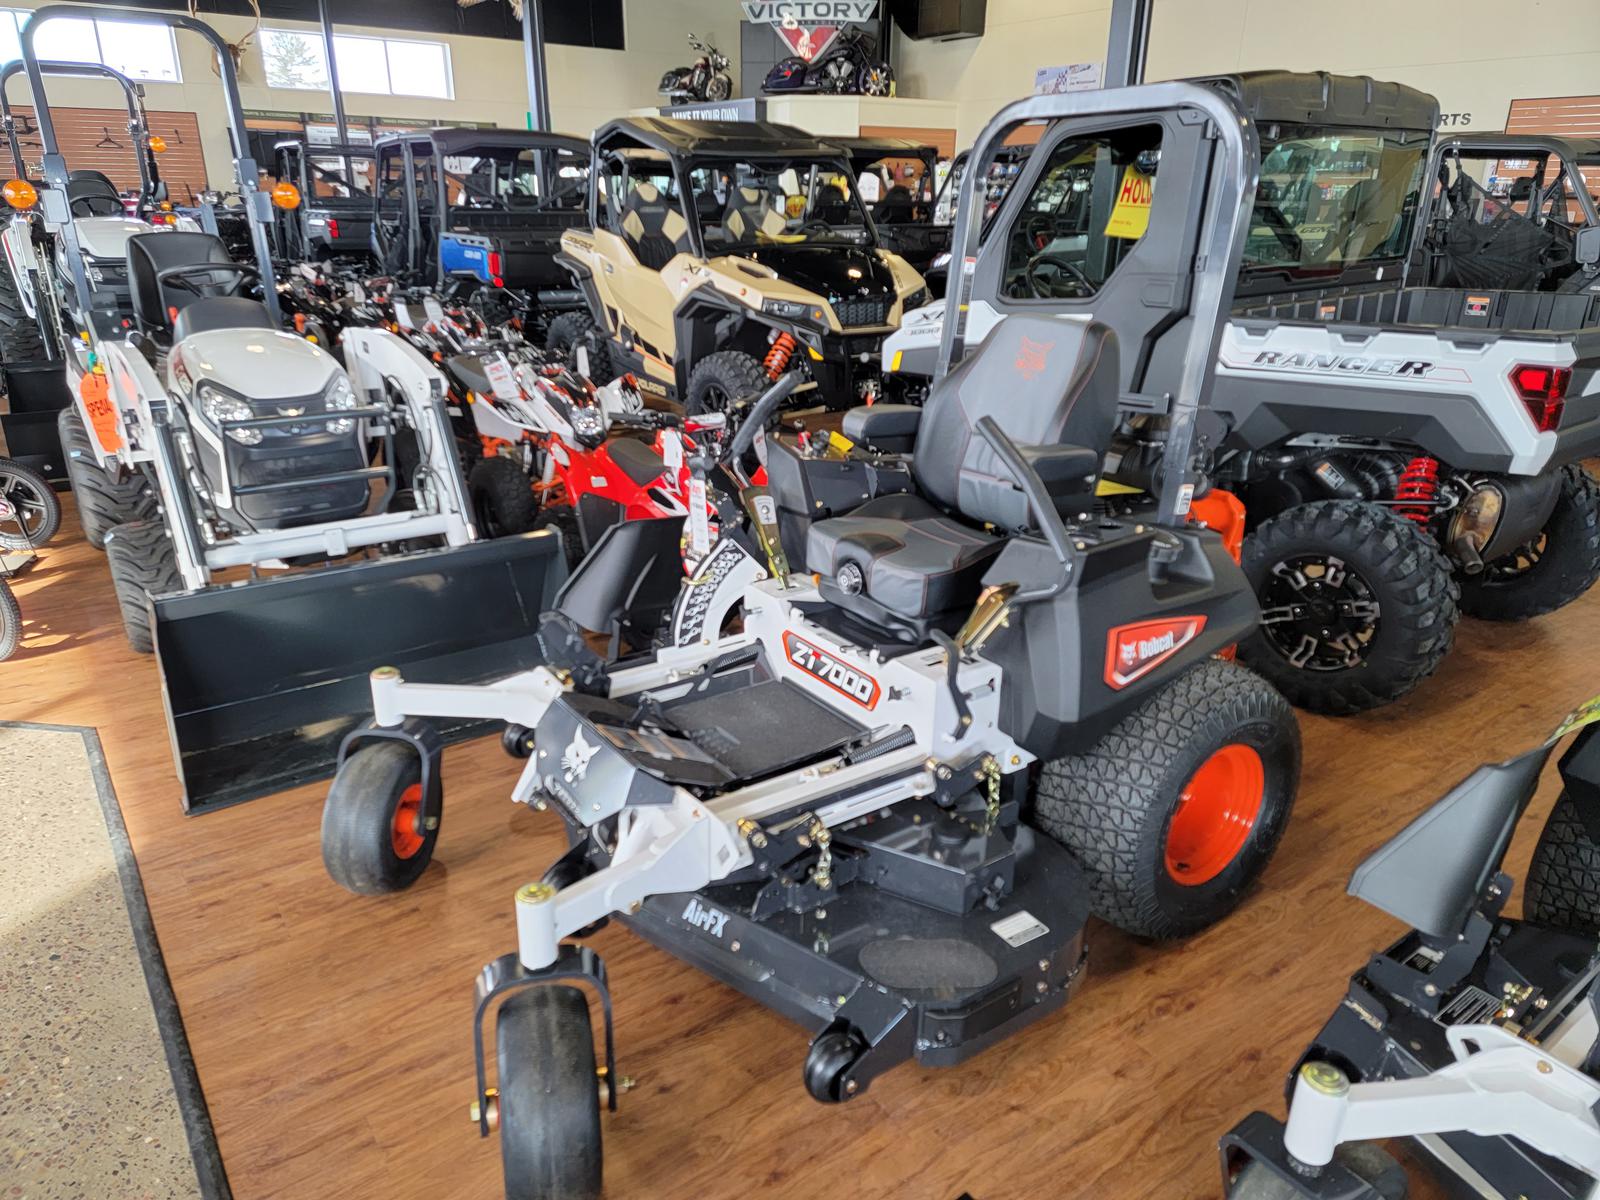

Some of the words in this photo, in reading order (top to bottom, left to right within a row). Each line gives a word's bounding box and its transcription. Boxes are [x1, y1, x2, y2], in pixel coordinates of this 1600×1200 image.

[748, 2, 870, 19] VICTORY
[700, 109, 721, 121] YOUR
[721, 107, 739, 122] OWN
[1438, 113, 1472, 126] RTS
[1253, 350, 1436, 378] RANGER
[1138, 631, 1175, 660] Bobcat
[682, 898, 731, 938] AirFX
